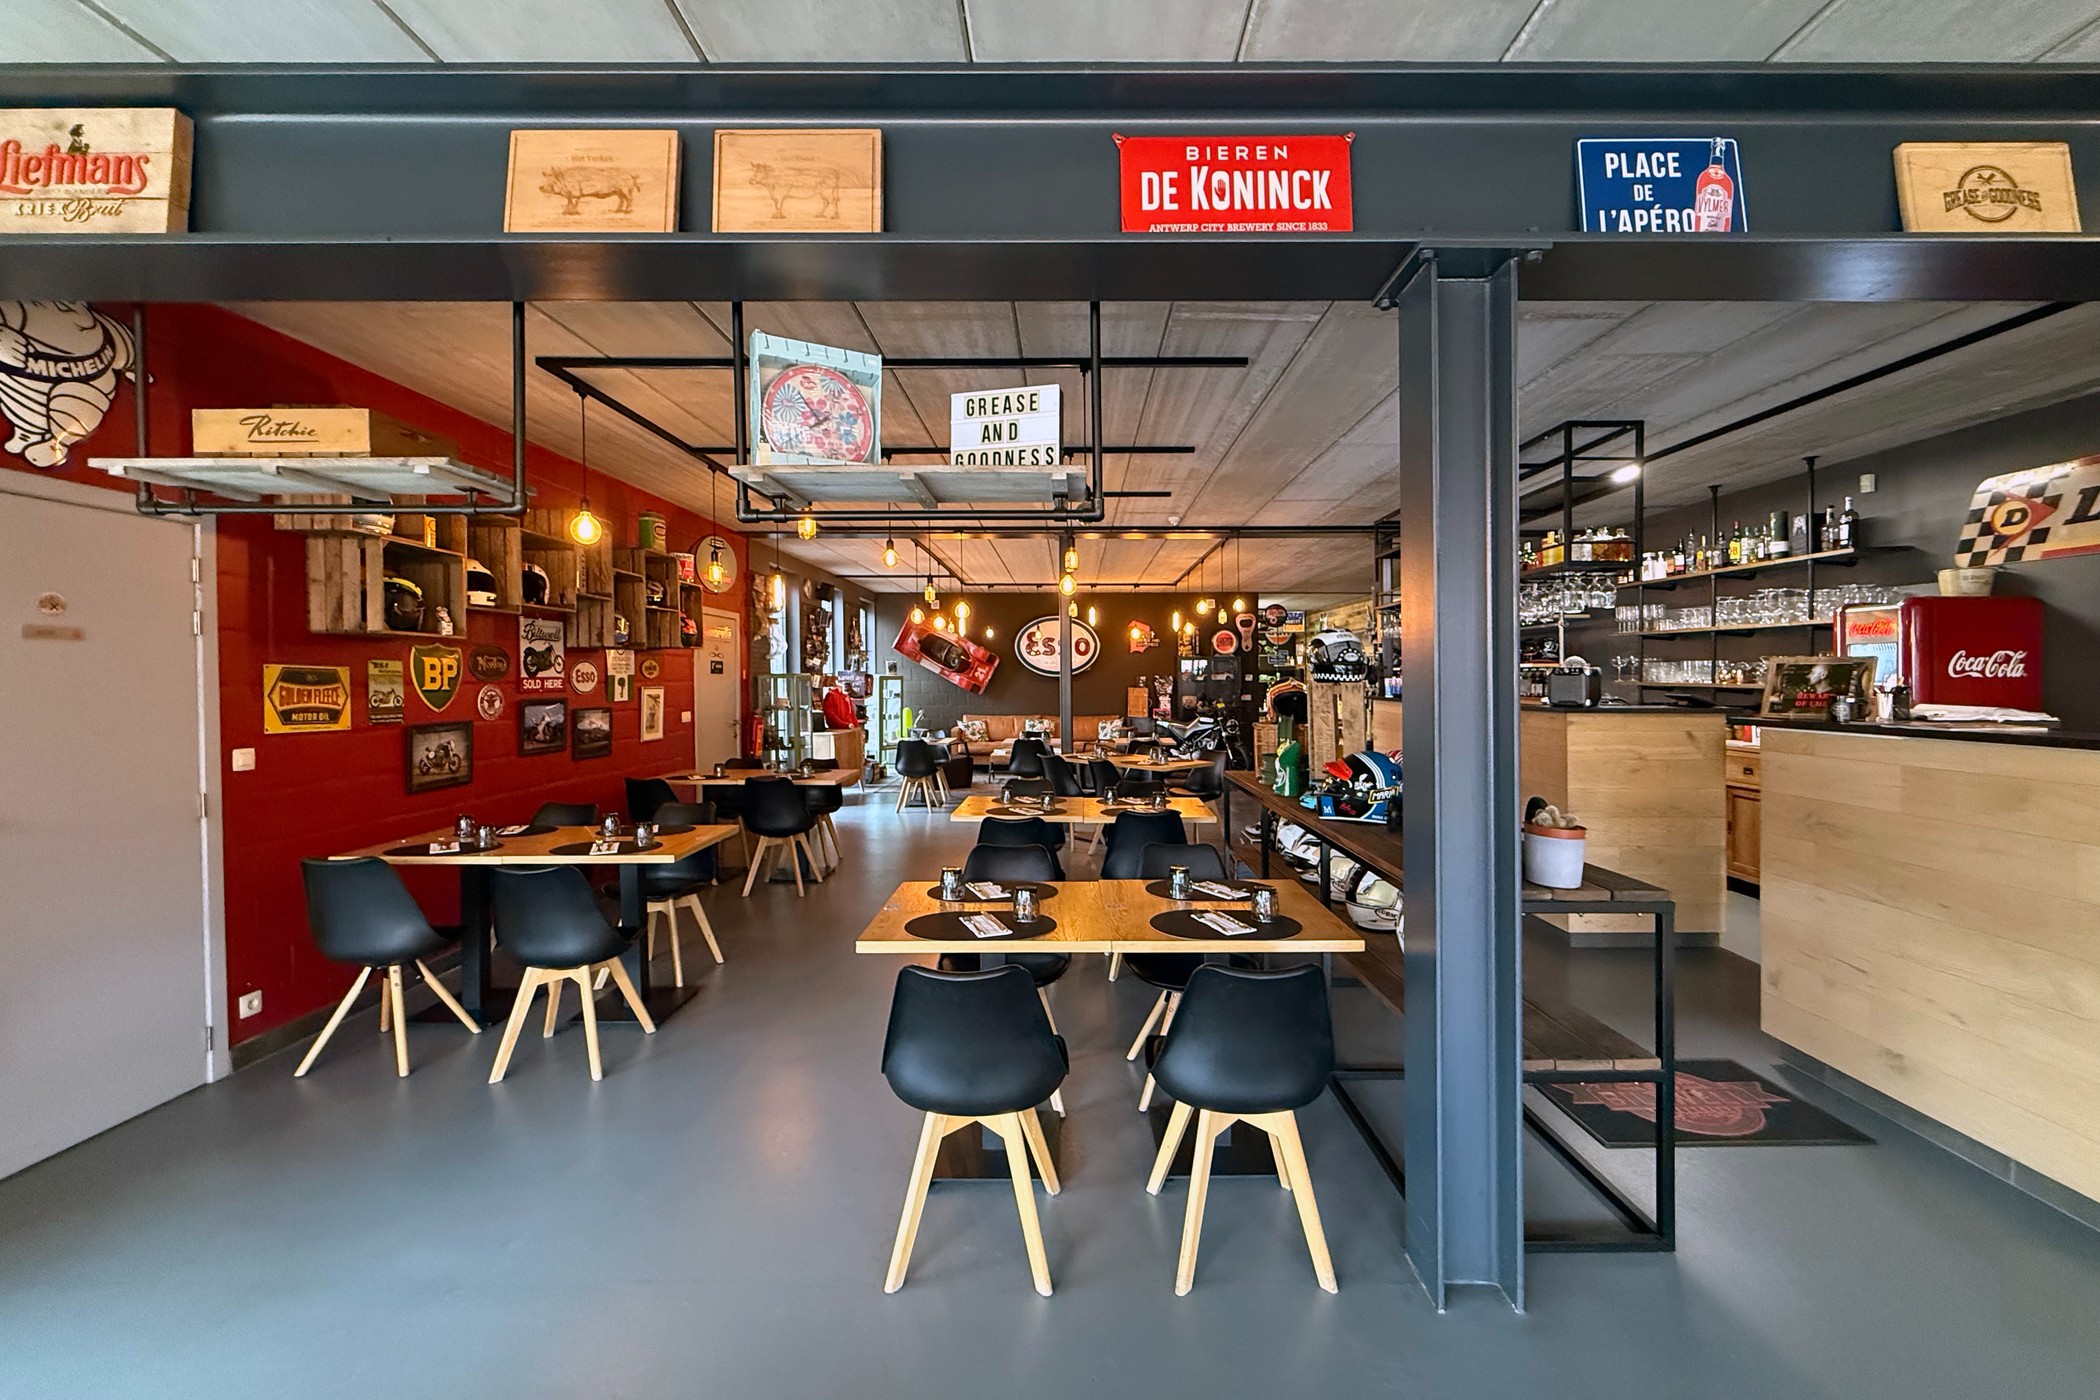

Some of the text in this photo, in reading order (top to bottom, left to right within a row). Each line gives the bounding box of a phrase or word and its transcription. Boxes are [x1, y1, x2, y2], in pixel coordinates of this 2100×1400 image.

[1186, 145, 1288, 161] BIEREN
[1605, 152, 1682, 178] PLACE
[1141, 165, 1333, 211] DE KONINCK
[1633, 184, 1654, 201] DE
[10, 198, 126, 223] KRIEK Brut
[1149, 221, 1328, 233] ANTWERP CITY BREWERY SINCE 1833
[26, 344, 114, 378] MICHELIN
[965, 393, 1039, 417] GREASE
[239, 415, 318, 439] Ritchie
[981, 422, 1019, 444] AND
[2000, 507, 2029, 528] D
[521, 620, 562, 643] Biltwell
[1849, 619, 1893, 638] Coca-Cola
[422, 656, 458, 690] BP
[1948, 650, 2028, 679] Coca-Cola
[523, 678, 563, 689] SOLD HERE
[291, 712, 318, 722] MOTOR
